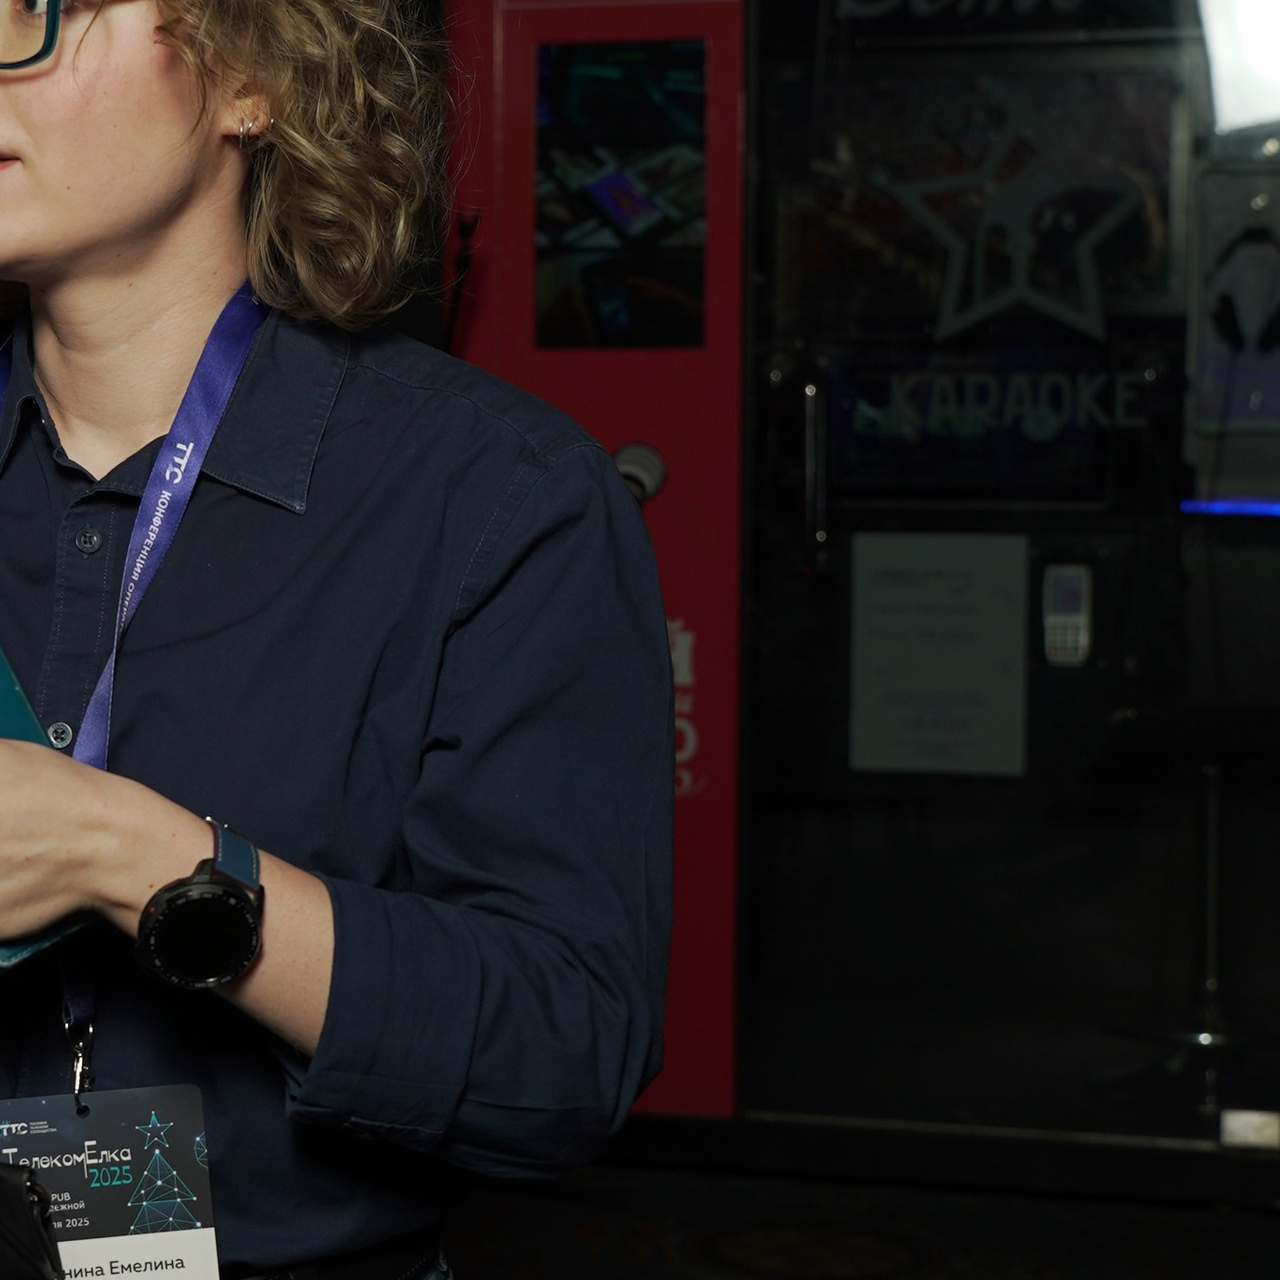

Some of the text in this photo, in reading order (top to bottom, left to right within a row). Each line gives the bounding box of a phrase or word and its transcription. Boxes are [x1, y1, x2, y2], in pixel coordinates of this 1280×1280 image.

[889, 371, 1147, 428] KARAOKE
[131, 489, 172, 582] КОНФЕРЕНЦИЯ
[88, 1165, 133, 1188] 2025
[51, 1191, 72, 1202] PUB
[65, 1217, 90, 1228] 2025
[109, 1258, 186, 1275] Емелина
